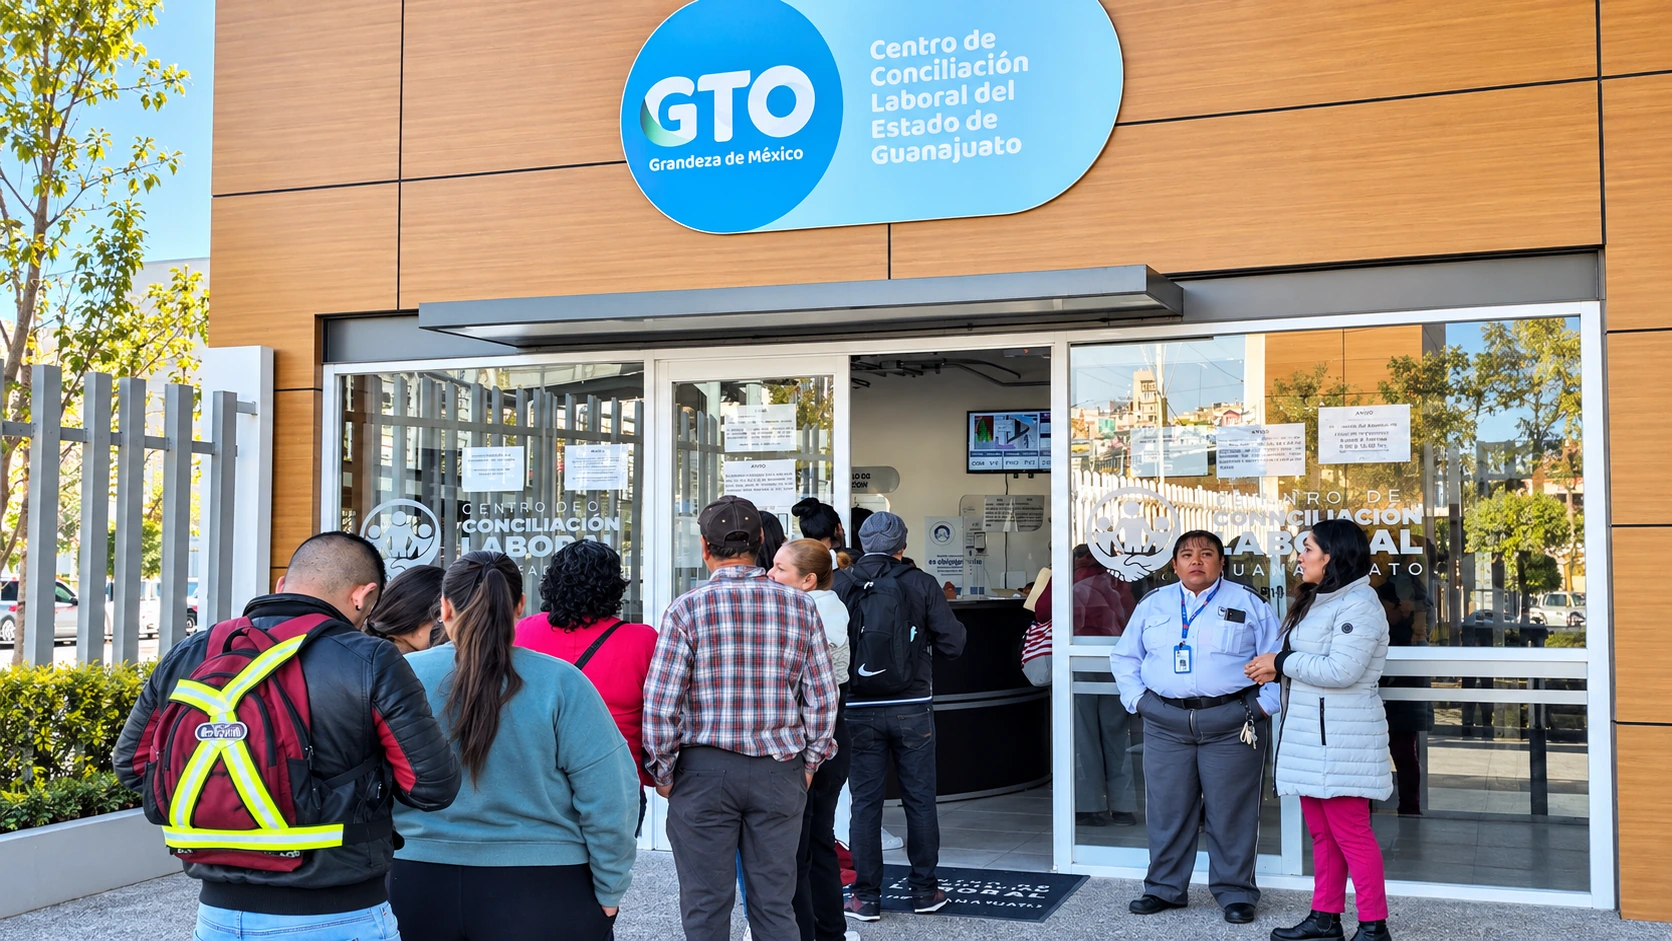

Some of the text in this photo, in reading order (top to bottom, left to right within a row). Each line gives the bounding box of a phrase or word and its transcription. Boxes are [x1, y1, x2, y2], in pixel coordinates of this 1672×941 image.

[870, 29, 996, 60] Centro de
[870, 50, 1029, 87] Conciliación
[640, 64, 816, 147] GTO
[871, 79, 1015, 113] Laboral del
[871, 109, 998, 139] Estado de
[649, 146, 804, 172] Grandeza de México
[871, 136, 1022, 165] Guanajuato
[1367, 489, 1401, 504] DE
[462, 513, 620, 533] CONCILIACIÓN
[461, 534, 612, 558] LABOR
[1218, 528, 1424, 556] LABAL
[1233, 562, 1423, 577] UANAATO
[889, 884, 1046, 899] LORAL
